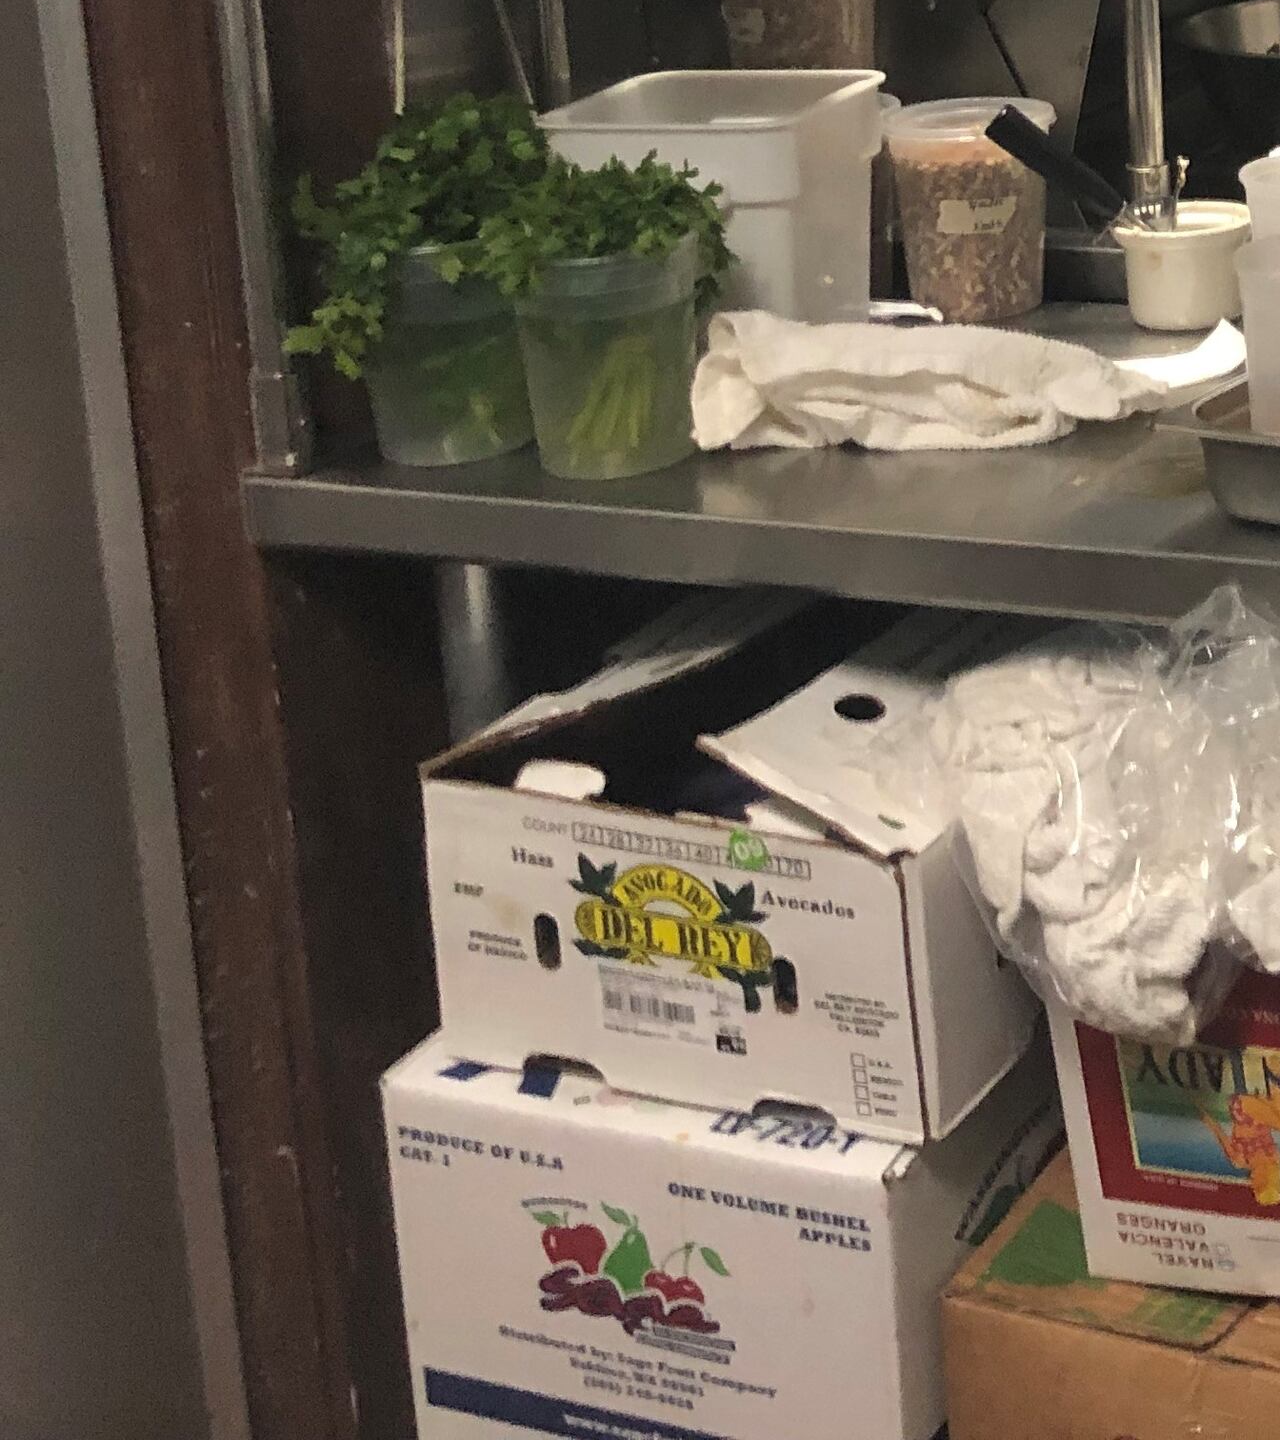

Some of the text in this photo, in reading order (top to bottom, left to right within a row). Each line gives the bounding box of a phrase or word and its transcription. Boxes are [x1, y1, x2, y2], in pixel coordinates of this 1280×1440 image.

[511, 846, 554, 869] Hass
[621, 867, 715, 915] AVOCADO
[760, 890, 856, 920] Avocados
[602, 910, 748, 966] DEL REY
[1135, 1044, 1257, 1100] LADY
[398, 1126, 484, 1155] PRODUCE
[490, 1144, 514, 1160] OF
[668, 1182, 872, 1233] ONE VOLUME BUSHEL
[1116, 1212, 1207, 1236] ORANGES
[800, 1227, 872, 1252] APPLES
[1117, 1232, 1209, 1253] VALENCIA
[1151, 1252, 1214, 1271] NAVEL
